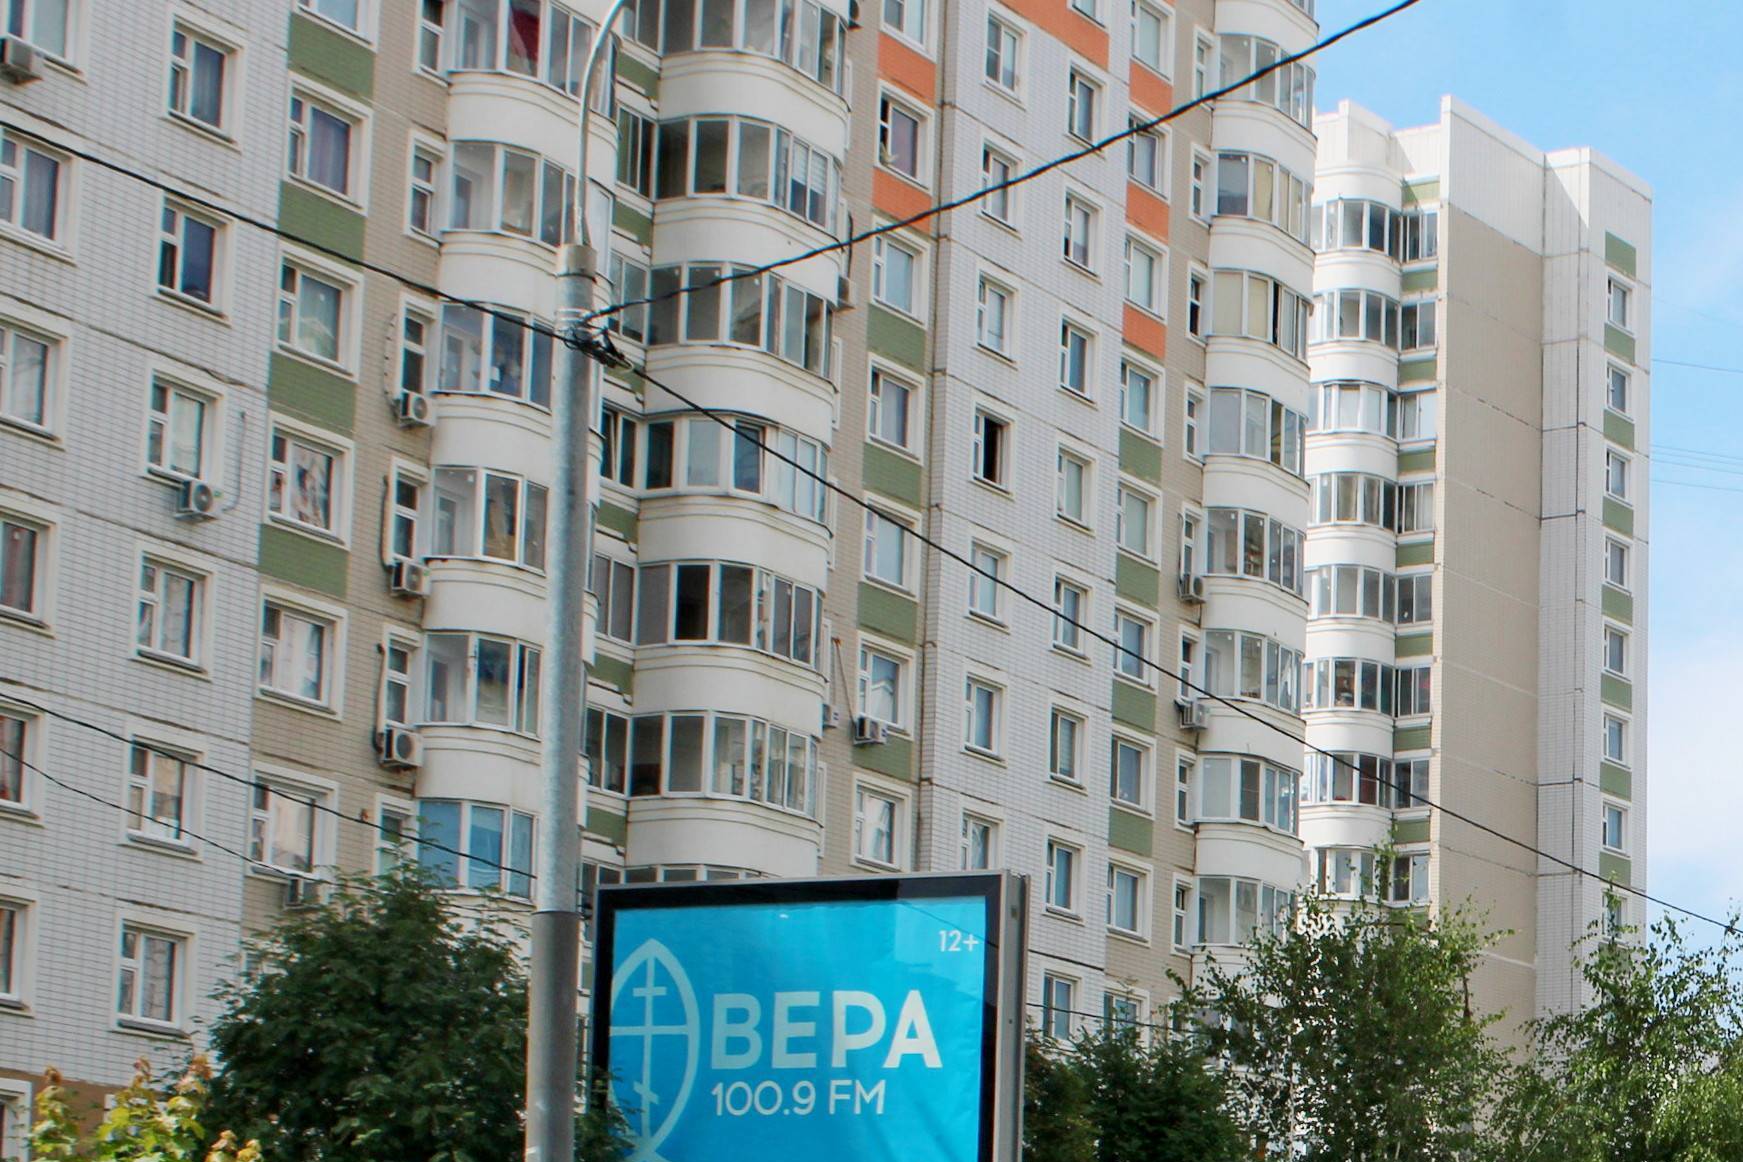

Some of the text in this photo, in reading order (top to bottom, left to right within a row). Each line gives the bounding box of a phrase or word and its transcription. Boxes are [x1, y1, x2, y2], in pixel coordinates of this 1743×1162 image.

[939, 929, 979, 952] 12+
[711, 989, 943, 1069] ВЕРА
[711, 1079, 886, 1116] 100.9 FM
